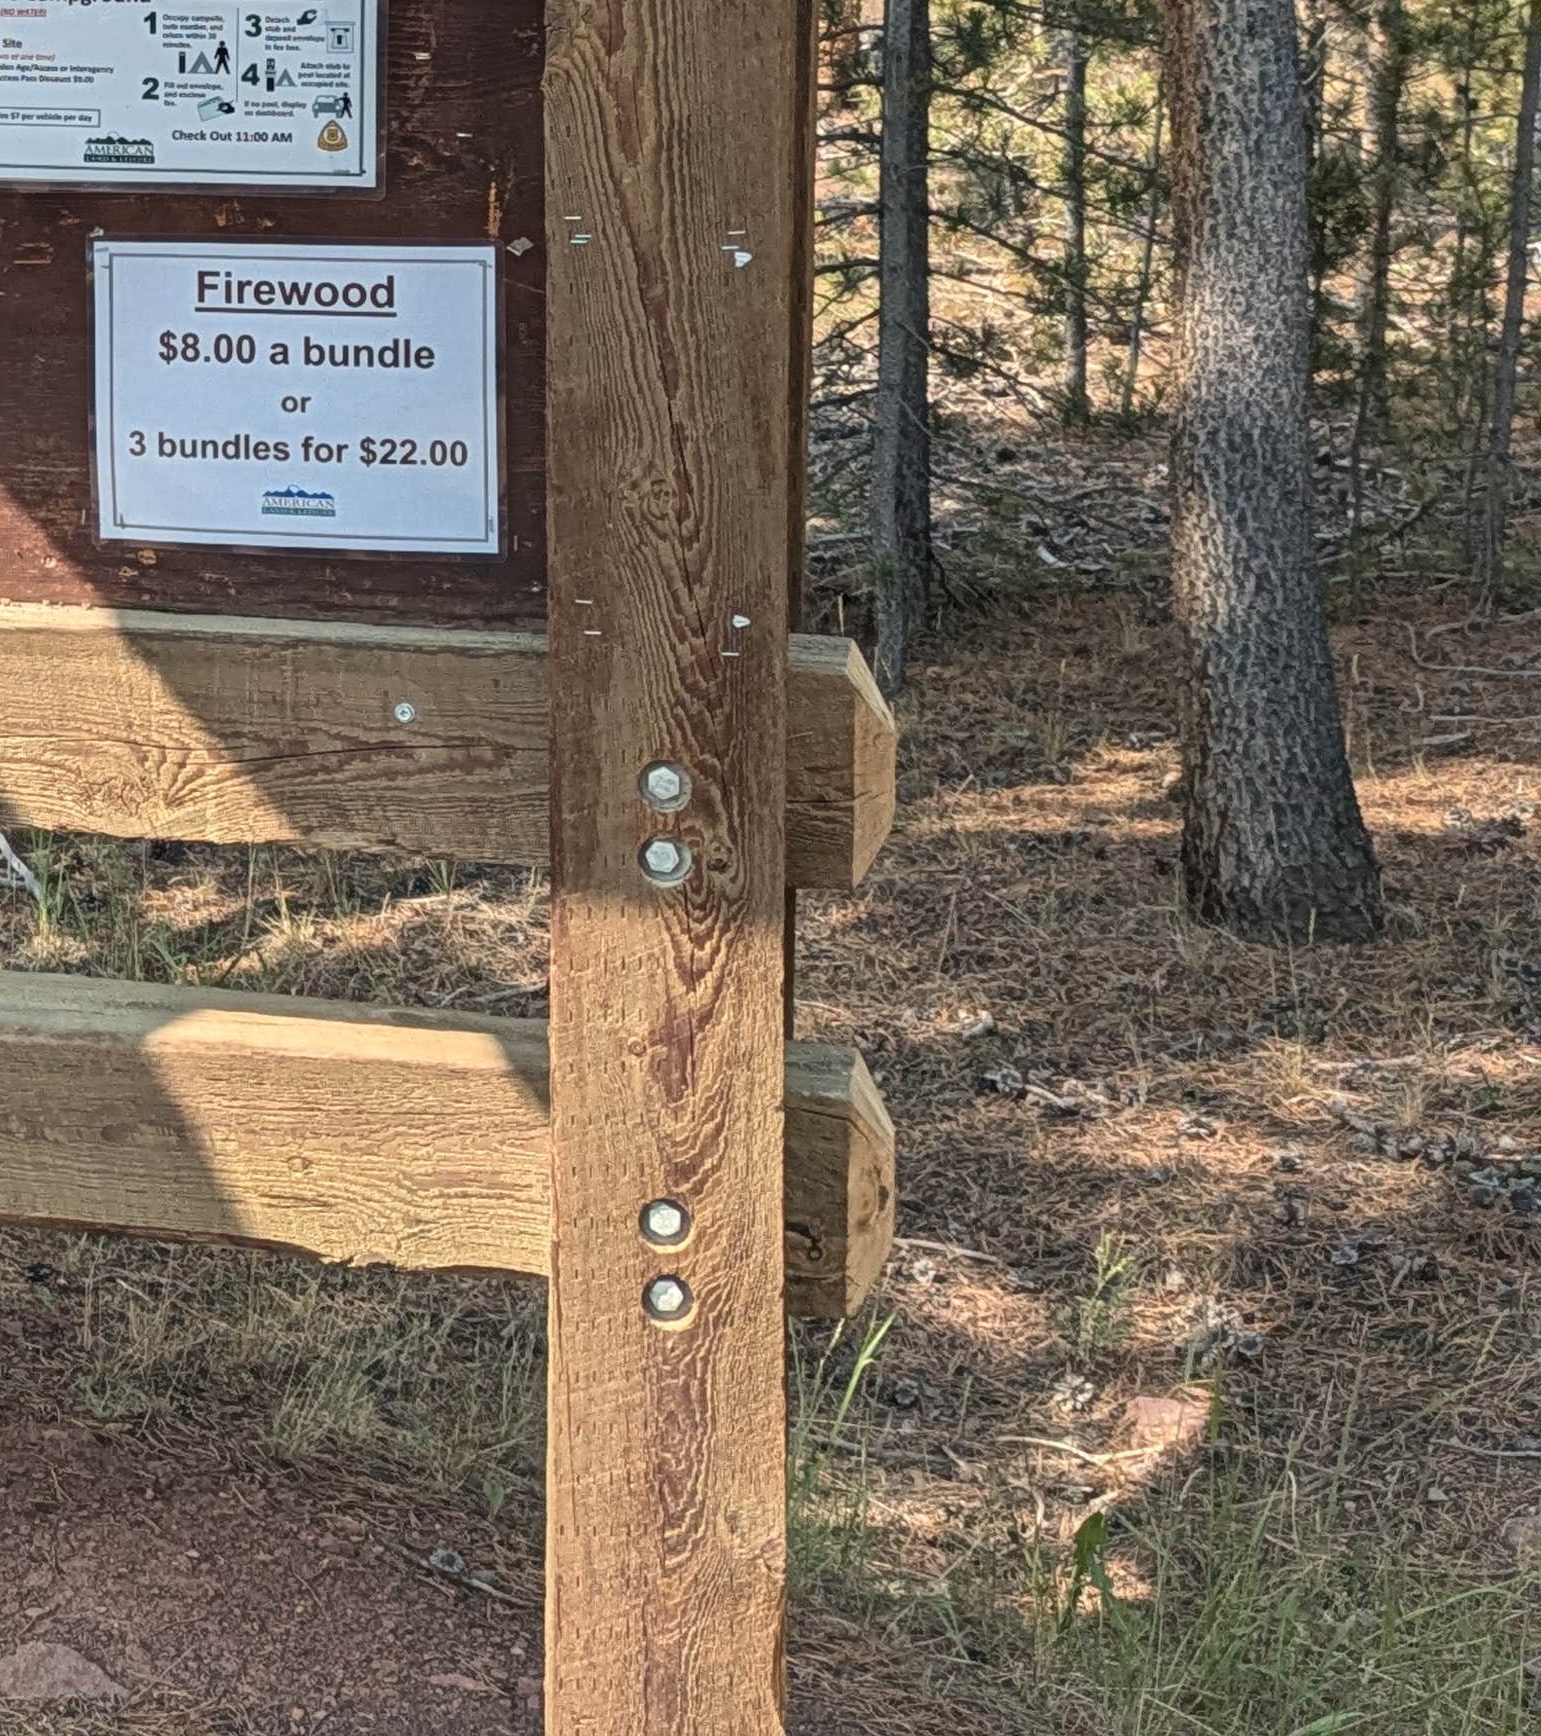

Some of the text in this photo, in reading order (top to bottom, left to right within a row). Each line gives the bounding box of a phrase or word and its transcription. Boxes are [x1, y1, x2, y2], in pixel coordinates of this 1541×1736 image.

[144, 11, 157, 34] 1
[245, 14, 262, 37] 3
[2, 38, 23, 49] Site
[241, 63, 260, 86] 4
[142, 77, 160, 100] 2
[172, 130, 293, 143] Check Out 11:00 AM
[85, 144, 154, 156] AMERICAN
[196, 270, 395, 309] Firewood
[159, 330, 436, 369] $8.00 a bundle
[281, 395, 311, 414] or
[128, 431, 469, 468] 3 bundles for $22.00
[263, 498, 335, 510] AMERICAN
